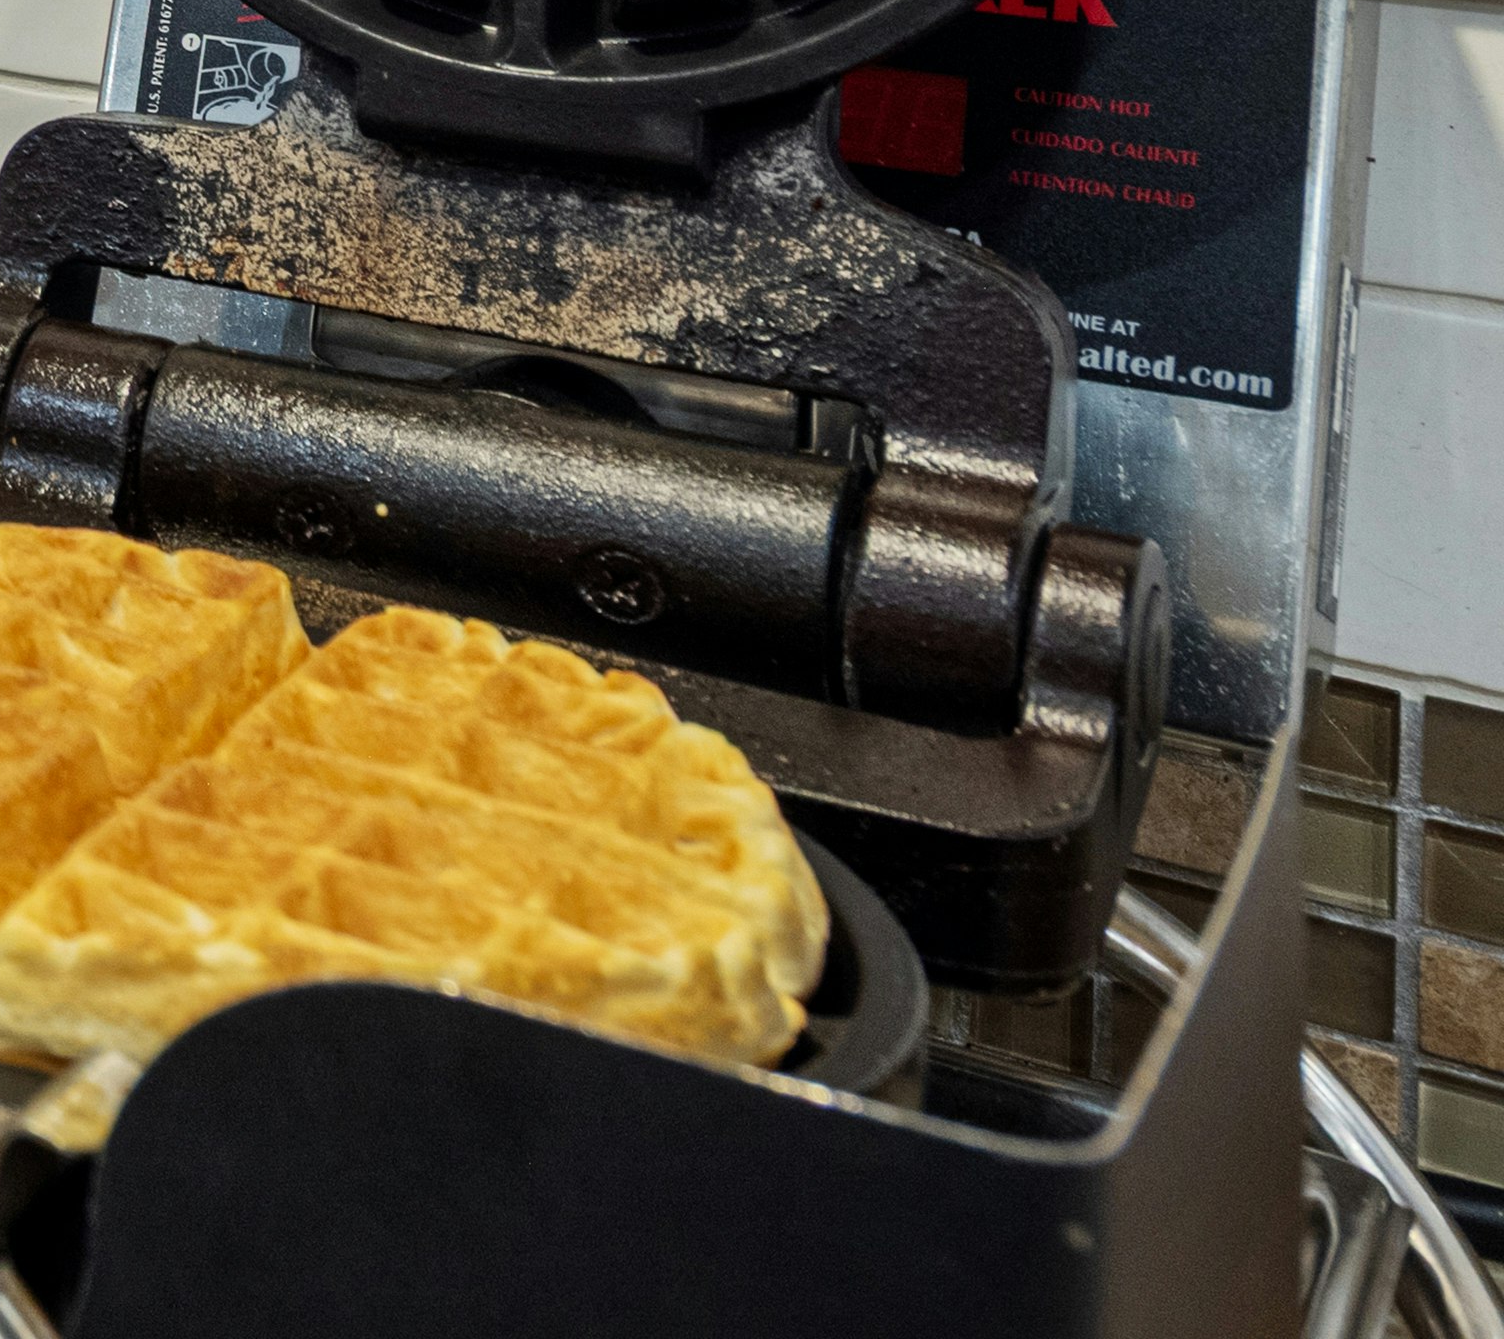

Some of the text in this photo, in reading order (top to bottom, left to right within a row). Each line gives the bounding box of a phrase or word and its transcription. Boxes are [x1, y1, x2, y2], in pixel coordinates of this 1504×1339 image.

[151, 36, 169, 86] PATENT:
[147, 82, 162, 114] U.S.
[1014, 86, 1152, 119] CAUTION HOT
[1011, 128, 1201, 168] CUIDADO CALIENTE
[1008, 169, 1196, 210] ATTENTION CHAUD
[1110, 319, 1141, 339] AT
[1078, 344, 1274, 399] alted.com
